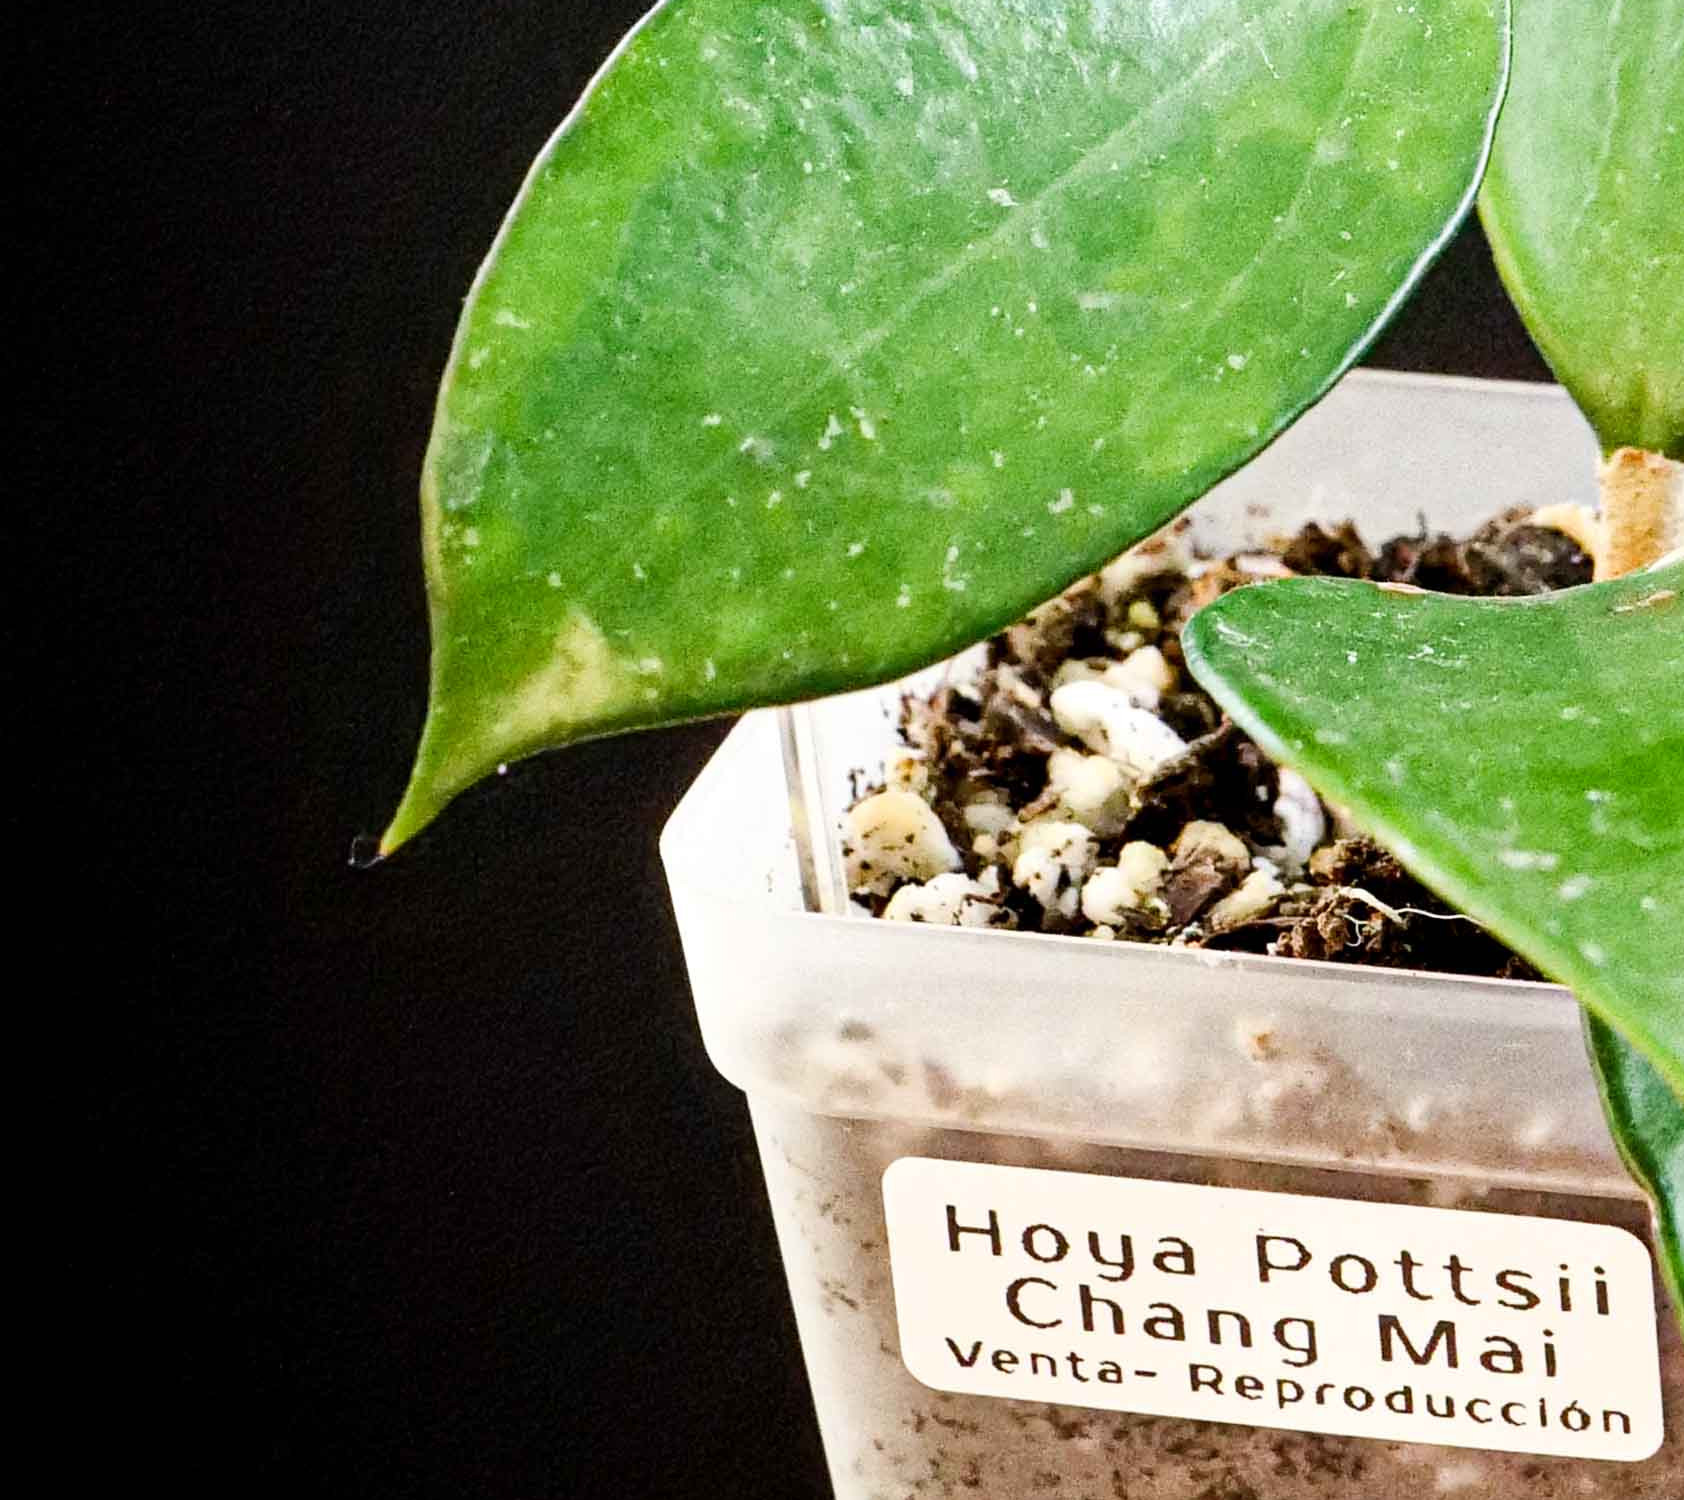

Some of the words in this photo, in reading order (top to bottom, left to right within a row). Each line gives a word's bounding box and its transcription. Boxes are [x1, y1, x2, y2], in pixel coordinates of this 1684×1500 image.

[945, 1204, 1197, 1283] Hoya
[1255, 1233, 1609, 1317] Pottsii
[1005, 1276, 1318, 1368] Chang
[1378, 1314, 1557, 1378] Mai
[945, 1337, 1157, 1385] Venta-
[1188, 1363, 1632, 1436] Reproducción
